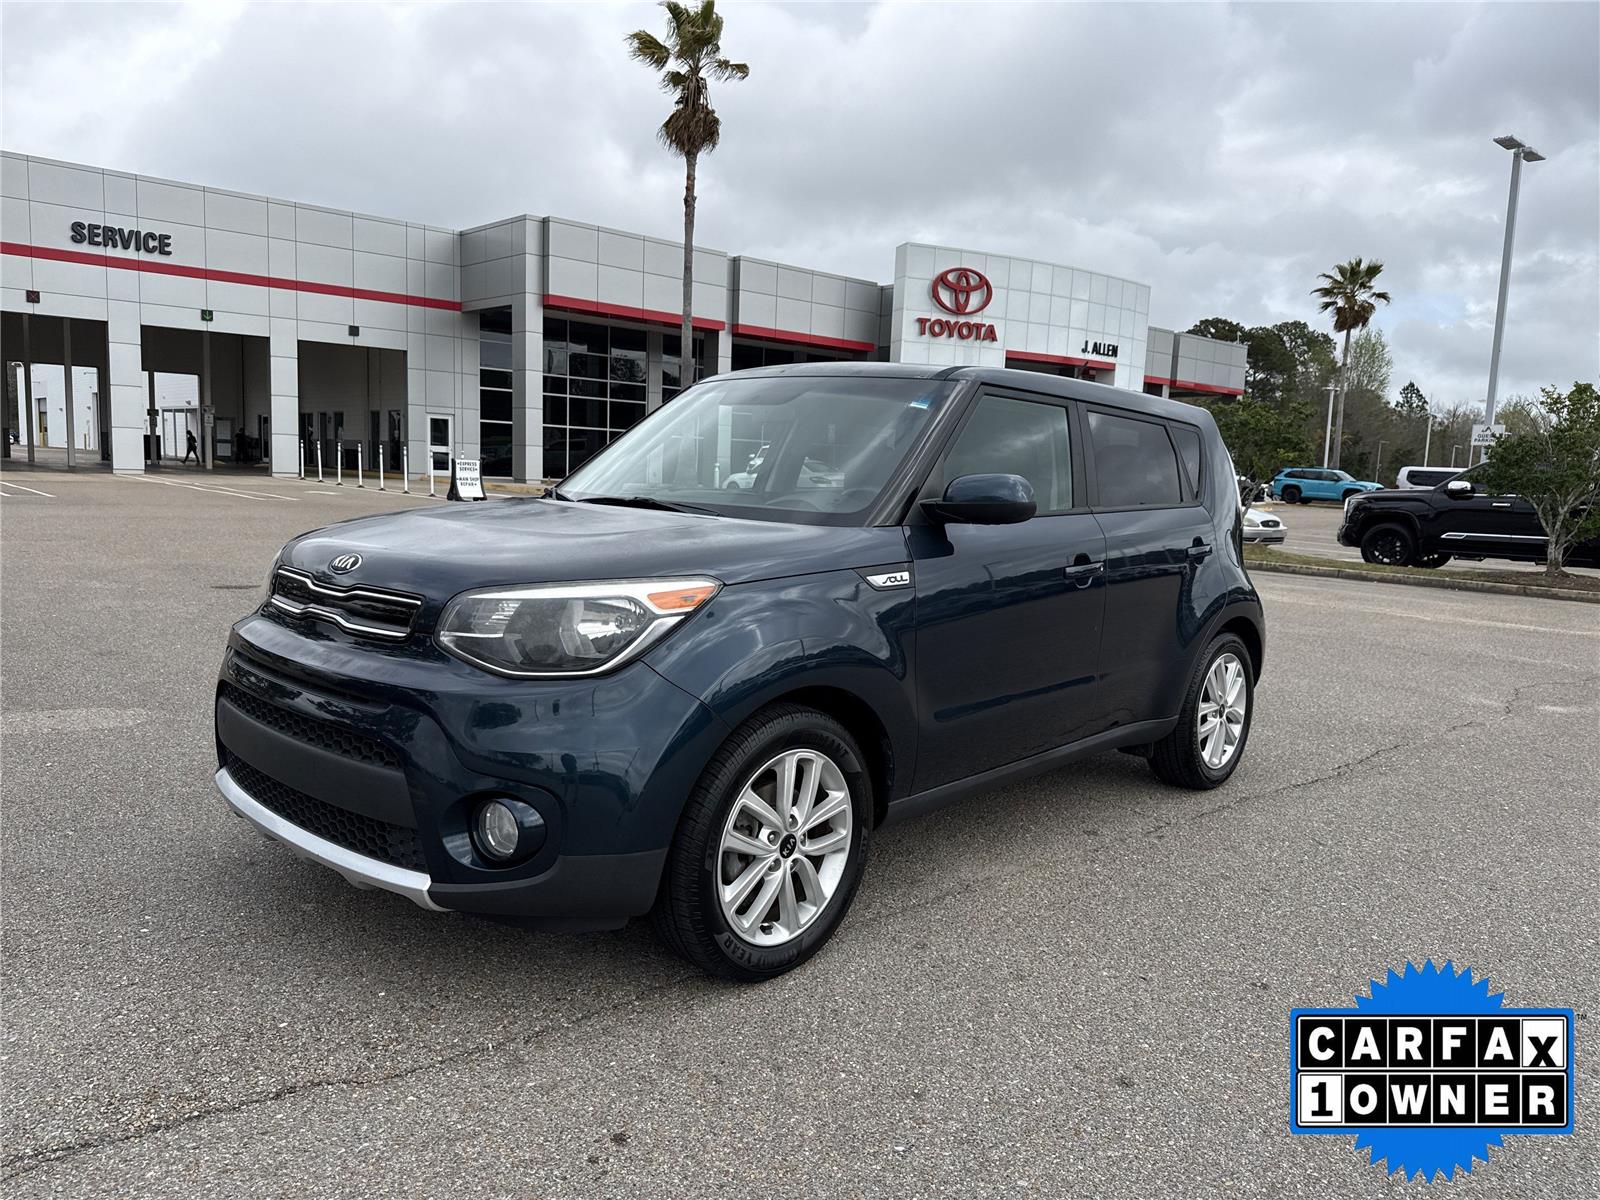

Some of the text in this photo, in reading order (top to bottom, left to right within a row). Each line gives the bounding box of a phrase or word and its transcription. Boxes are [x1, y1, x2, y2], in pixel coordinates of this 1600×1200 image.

[71, 221, 172, 255] SERVICE
[917, 318, 997, 342] TOYOTA
[1081, 340, 1118, 358] J. ALLEN
[332, 555, 355, 569] KIA
[882, 575, 908, 584] SOUL
[782, 838, 795, 856] KIA
